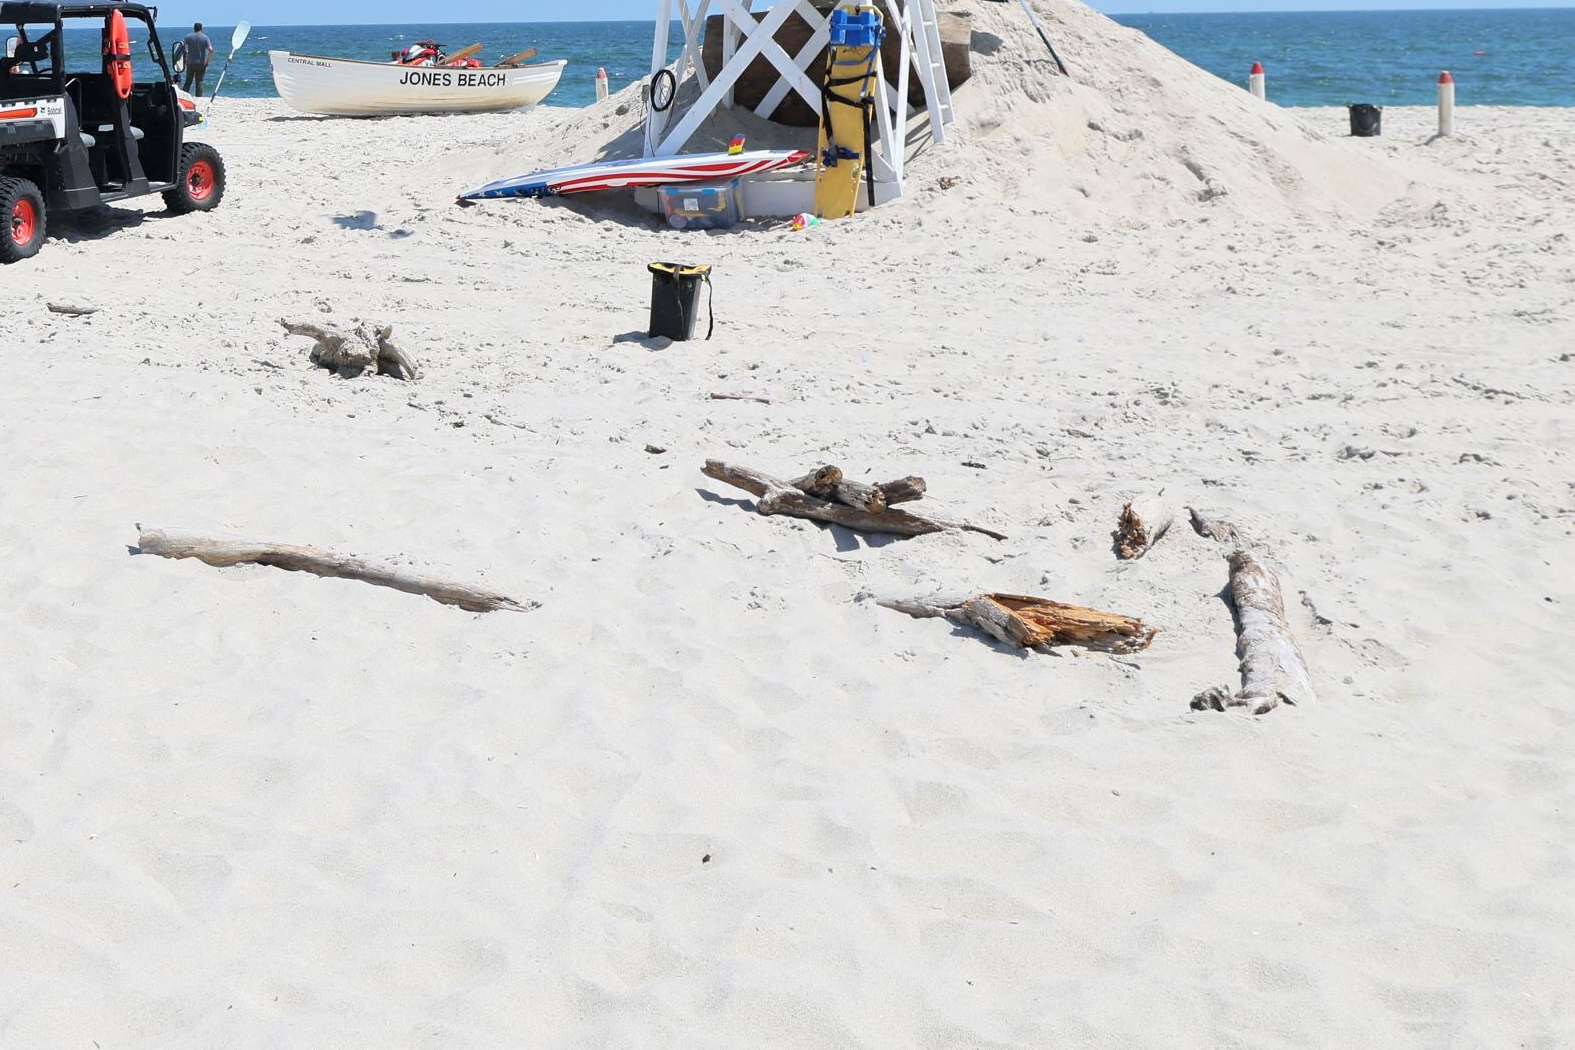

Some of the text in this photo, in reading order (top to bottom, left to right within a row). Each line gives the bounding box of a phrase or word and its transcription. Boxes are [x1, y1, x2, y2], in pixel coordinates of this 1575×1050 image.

[287, 57, 332, 68] CENTRAL MALL
[399, 71, 506, 87] JONES BEACH
